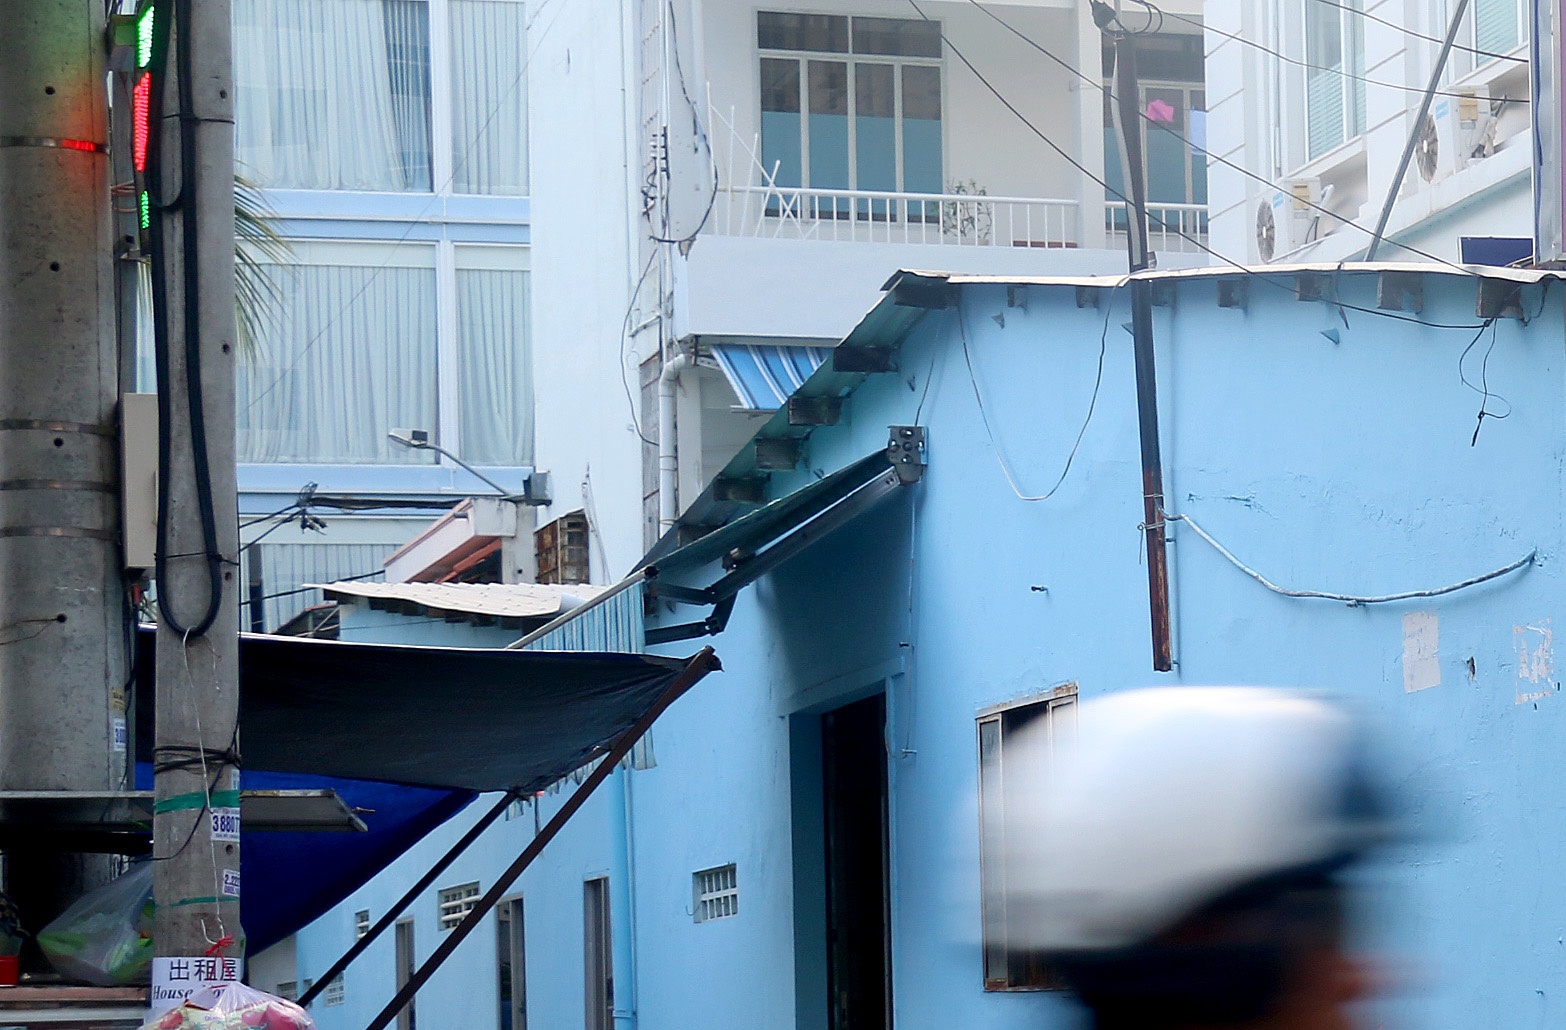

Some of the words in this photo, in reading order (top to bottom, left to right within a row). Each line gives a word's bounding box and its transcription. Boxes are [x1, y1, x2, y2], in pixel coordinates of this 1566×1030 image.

[169, 959, 237, 981] 出租屋
[154, 985, 194, 1000] House
